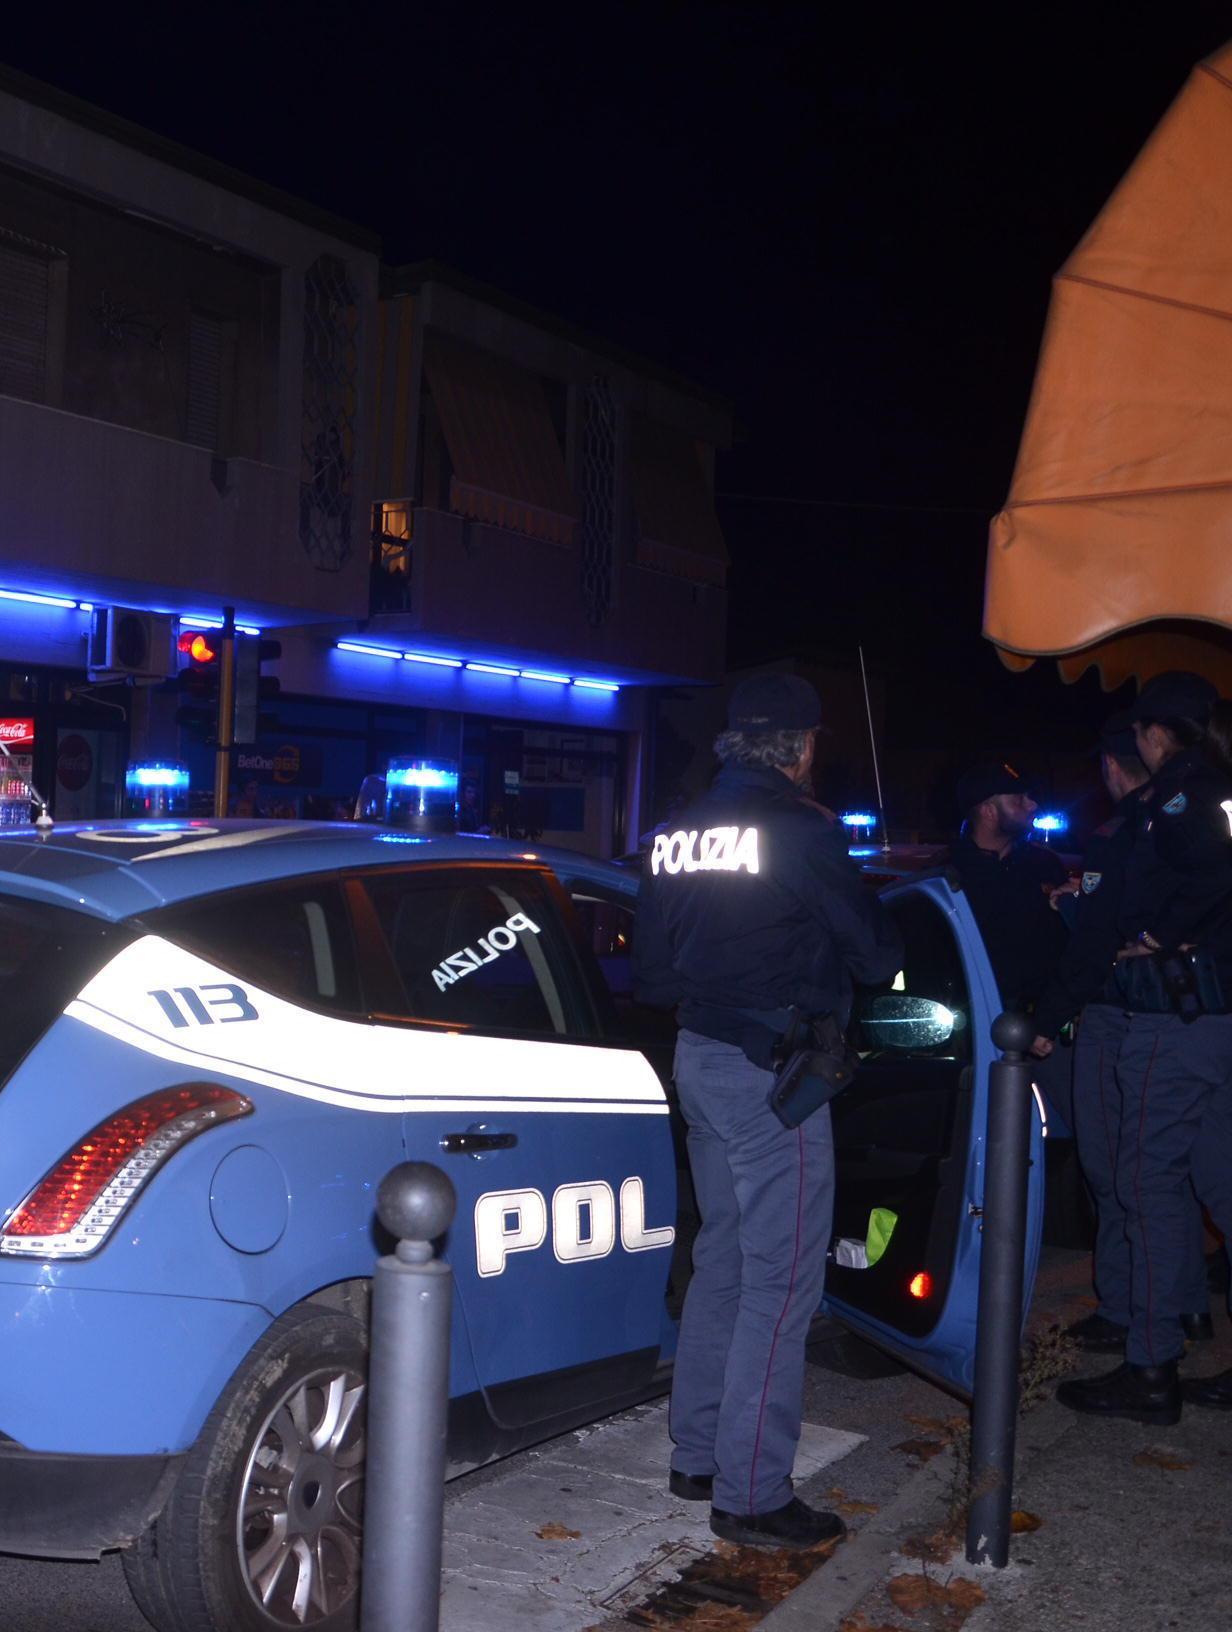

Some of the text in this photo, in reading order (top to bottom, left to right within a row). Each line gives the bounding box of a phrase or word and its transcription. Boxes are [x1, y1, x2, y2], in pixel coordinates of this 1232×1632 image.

[651, 826, 760, 876] POLIZIA
[146, 983, 259, 1028] 113
[474, 1175, 676, 1279] POL
